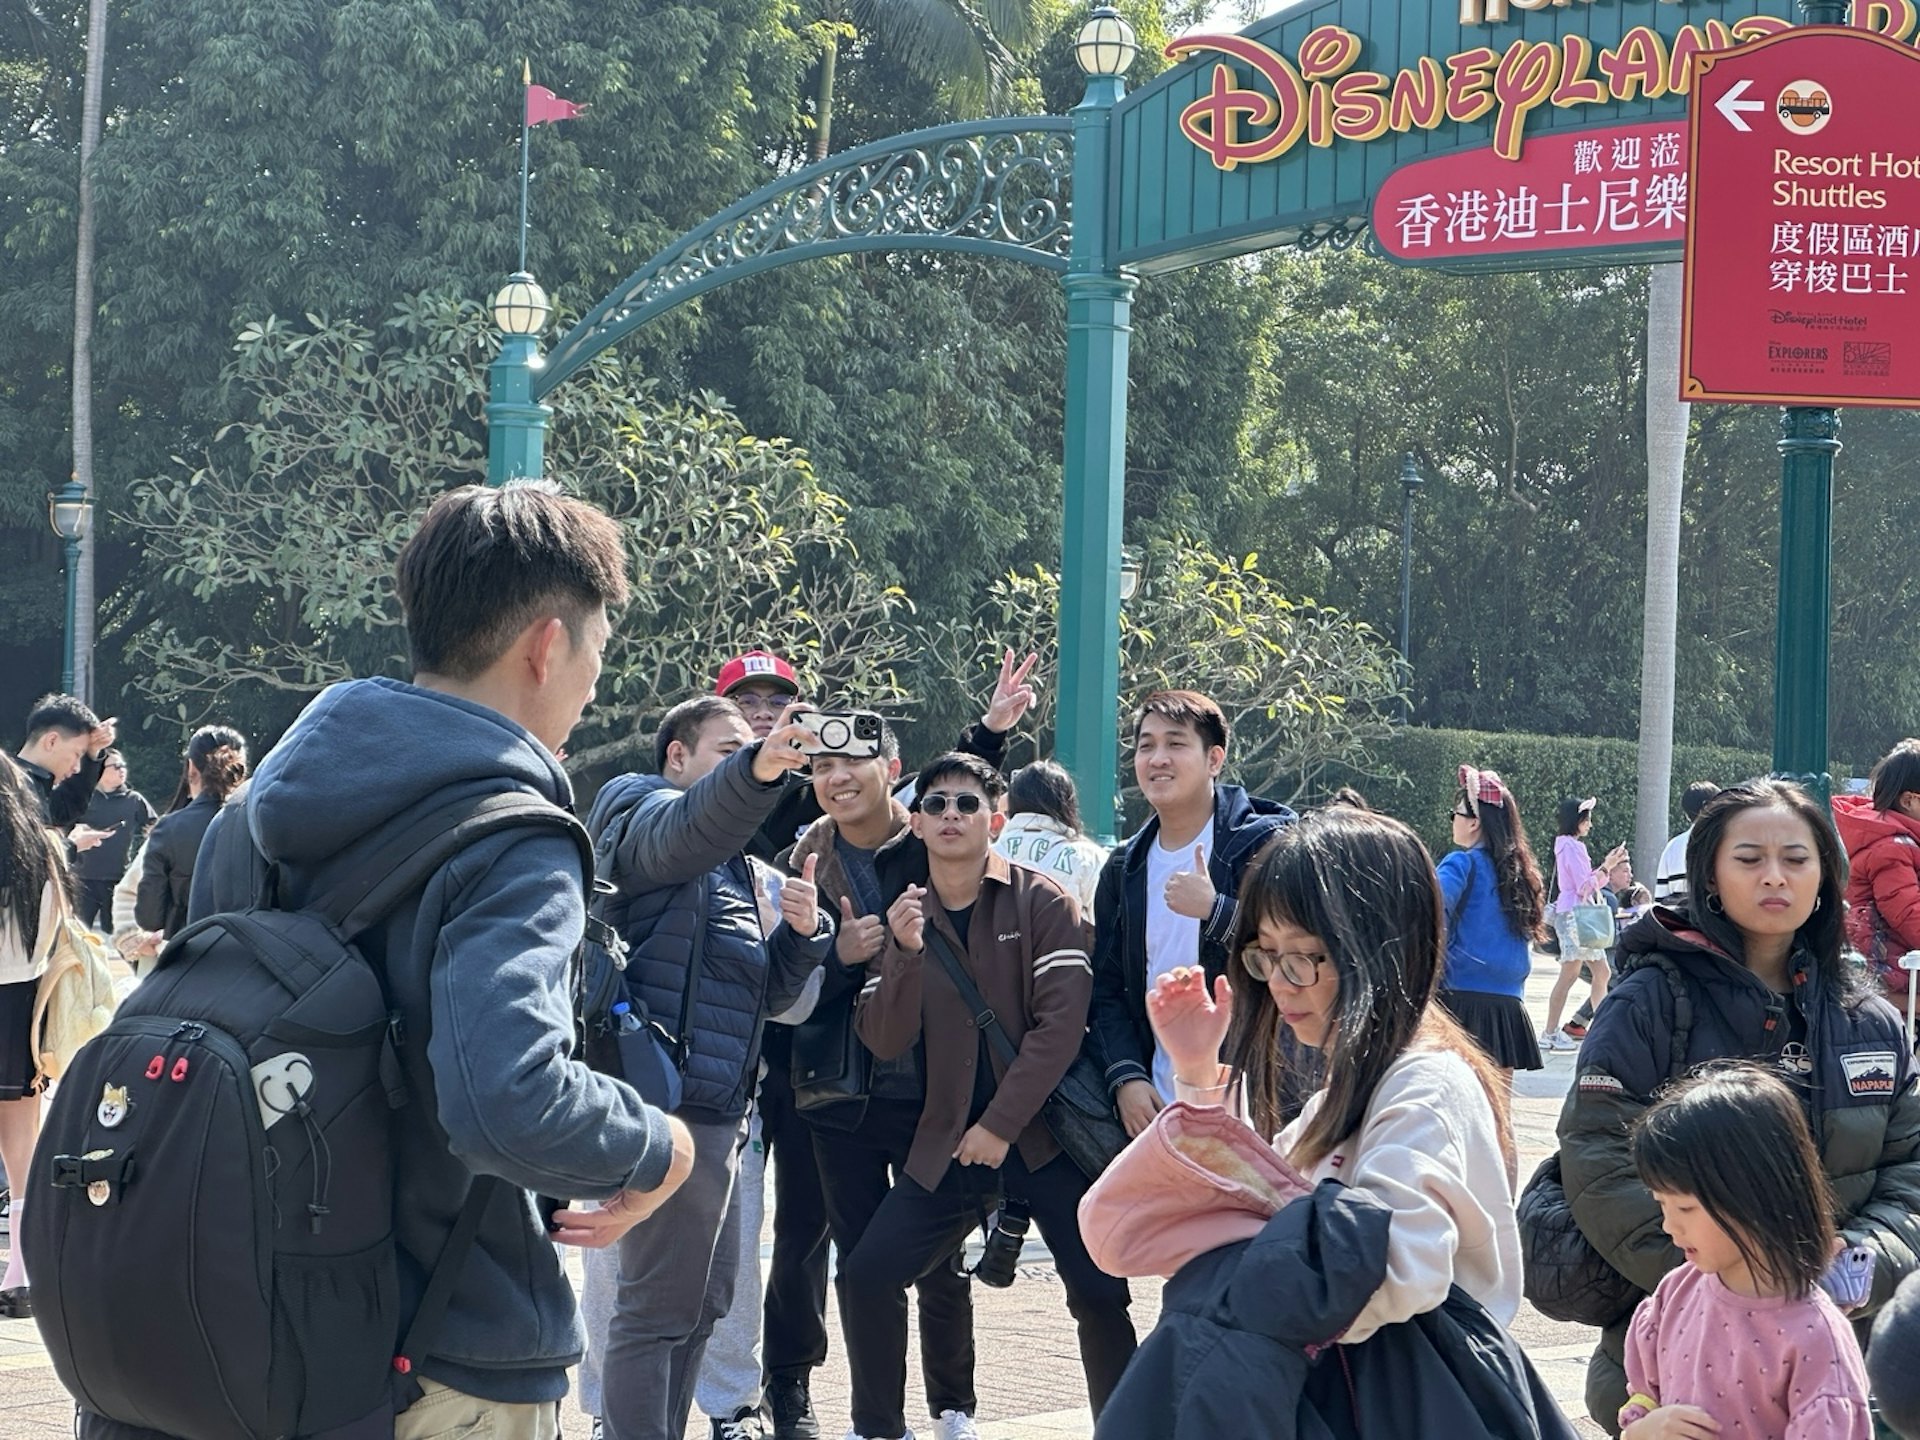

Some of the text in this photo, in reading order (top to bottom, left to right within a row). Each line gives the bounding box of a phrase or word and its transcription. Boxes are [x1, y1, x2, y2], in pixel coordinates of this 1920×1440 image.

[1573, 132, 1681, 175] 歡迎蒞
[1774, 149, 1863, 177] Resort
[1395, 172, 1687, 249] 香港迪士尼樂
[1773, 180, 1887, 209] Shuttles
[1769, 258, 1909, 294] 穿梭巴士
[1768, 346, 1829, 361] EXPLORERS
